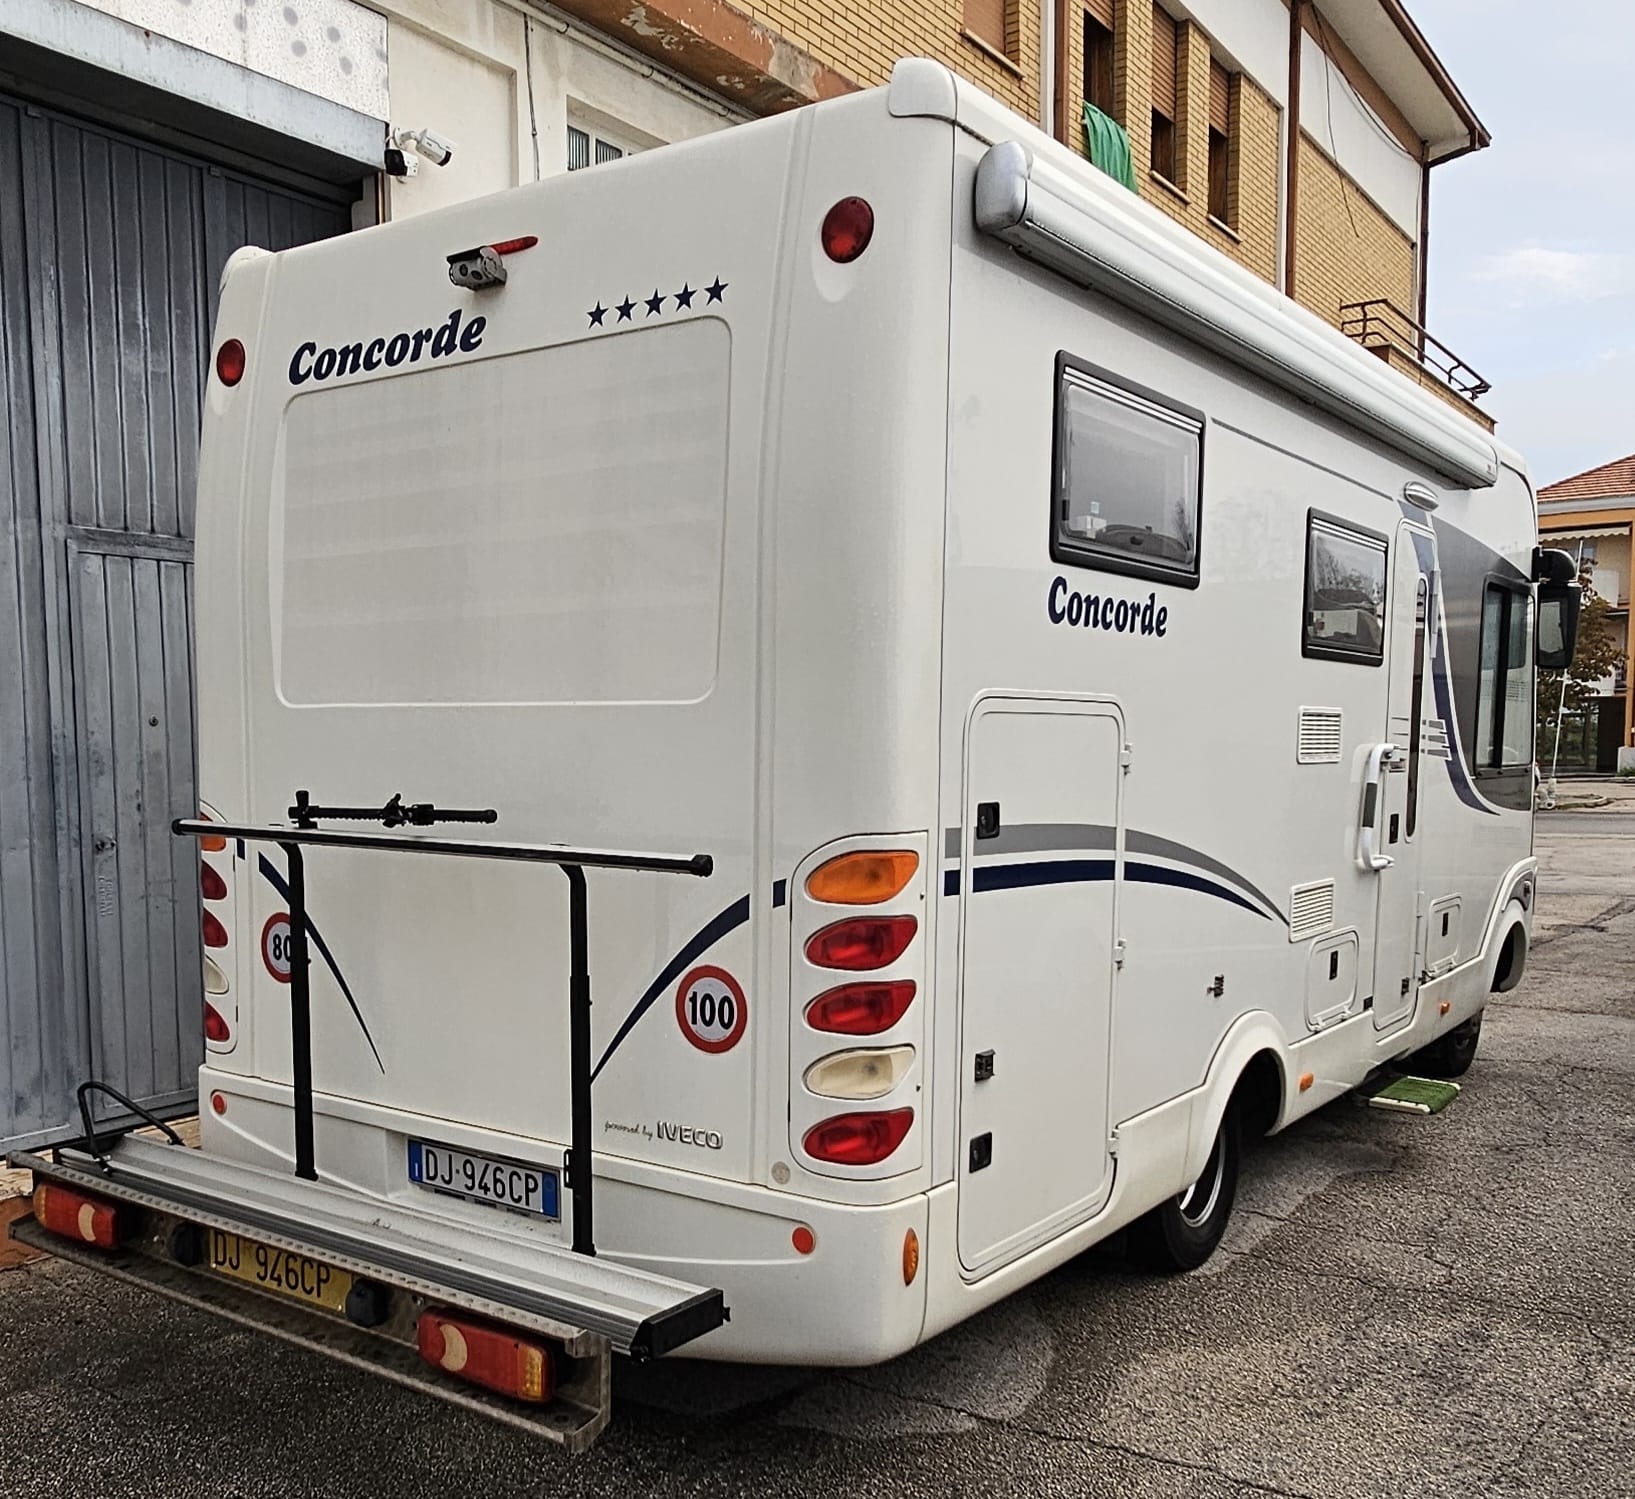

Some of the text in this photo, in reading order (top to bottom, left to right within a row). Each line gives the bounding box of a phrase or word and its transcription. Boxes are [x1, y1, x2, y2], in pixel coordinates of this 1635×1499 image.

[288, 308, 487, 386] Concorde
[1048, 575, 1168, 638] Concorde
[272, 933, 291, 962] 80
[688, 990, 735, 1030] 100
[641, 1125, 653, 1141] by
[656, 1120, 723, 1150] IVECO
[214, 1231, 331, 1298] DJ 946CP
